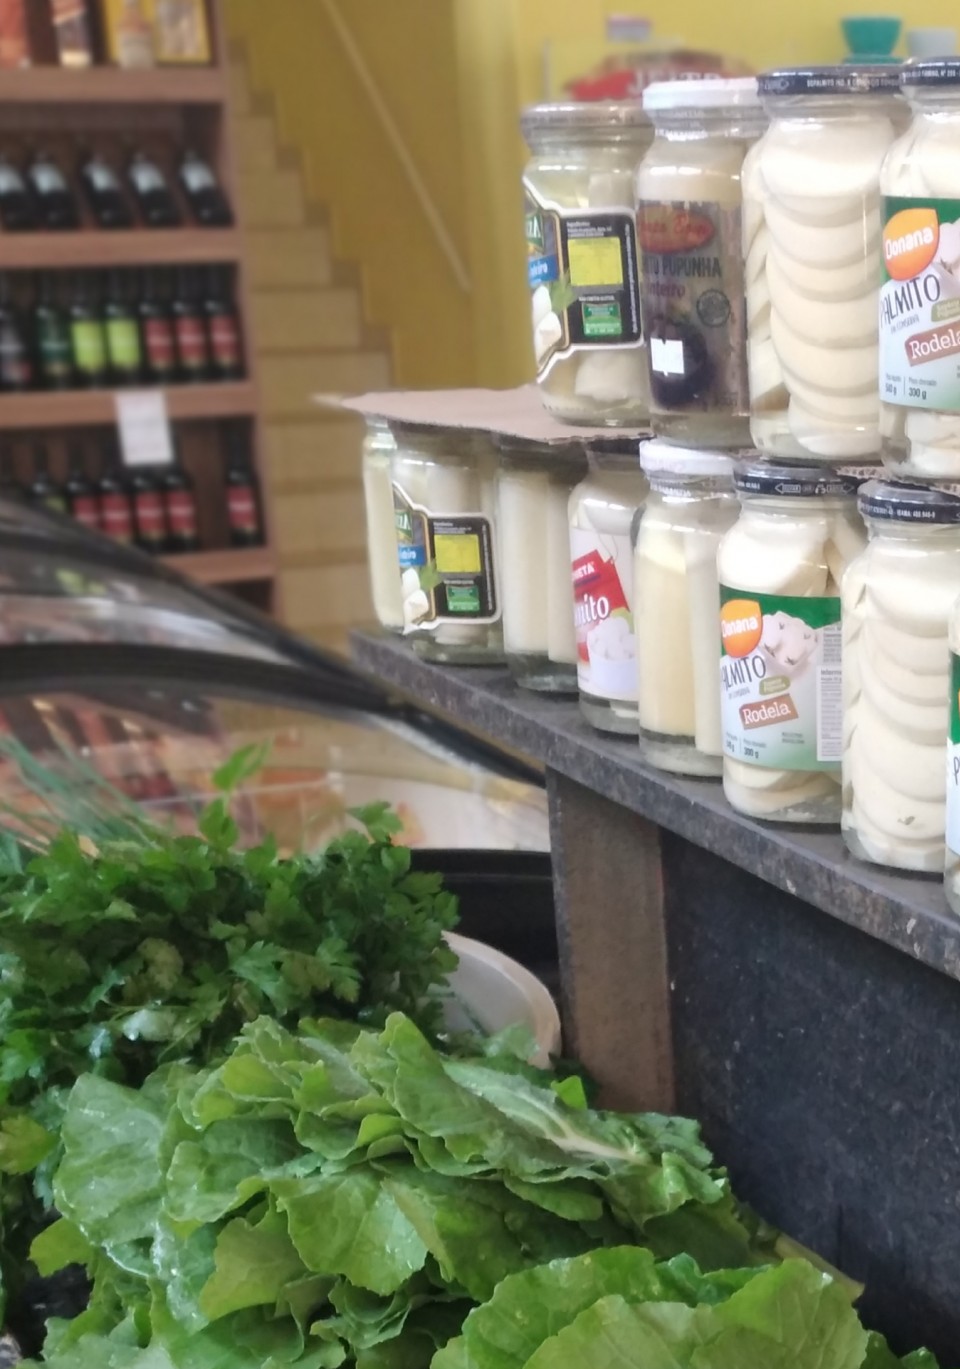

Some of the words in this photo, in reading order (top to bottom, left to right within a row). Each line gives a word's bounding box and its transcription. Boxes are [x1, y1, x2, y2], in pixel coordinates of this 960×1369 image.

[885, 227, 934, 259] Donana
[721, 616, 758, 638] Donana
[722, 656, 766, 692] ALMITO
[743, 702, 791, 725] Rodela
